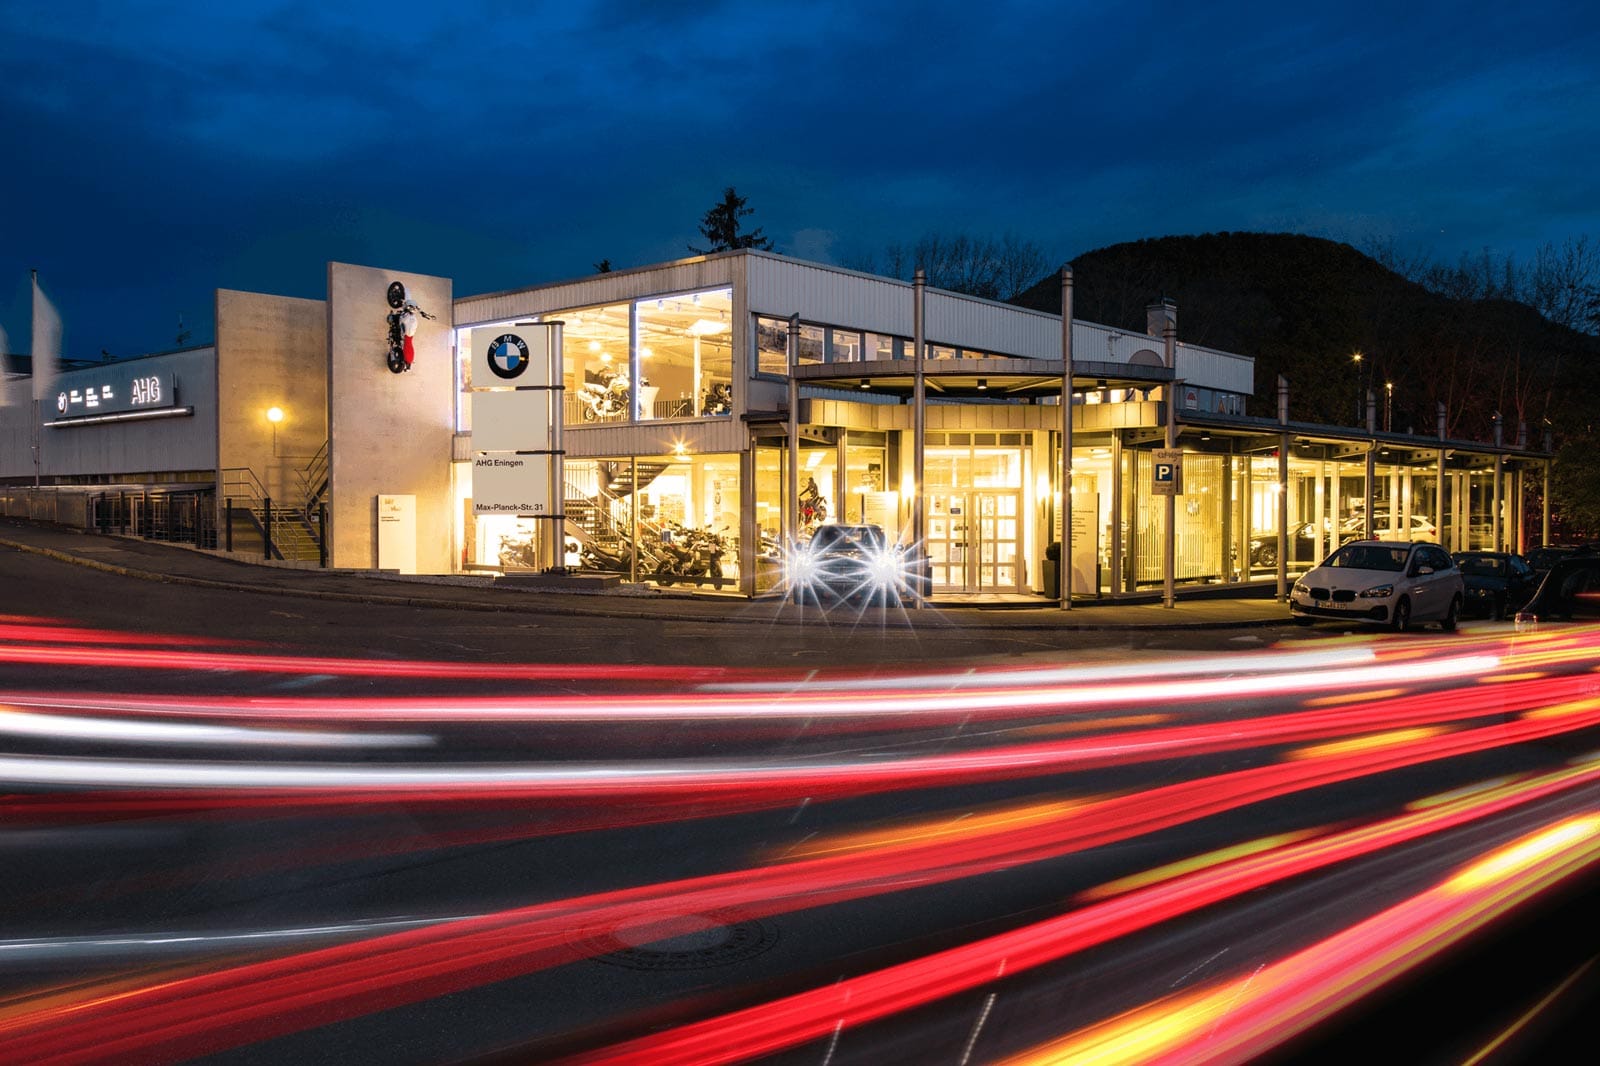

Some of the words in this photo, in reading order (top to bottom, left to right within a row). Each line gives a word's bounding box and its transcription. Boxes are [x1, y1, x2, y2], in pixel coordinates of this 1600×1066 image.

[491, 335, 526, 350] BMW
[131, 376, 160, 405] AHG
[476, 459, 493, 467] AHG
[494, 459, 524, 468] Eningen
[1158, 465, 1170, 480] P
[476, 503, 533, 511] Max-Planck-Str.
[534, 503, 543, 511] 31
